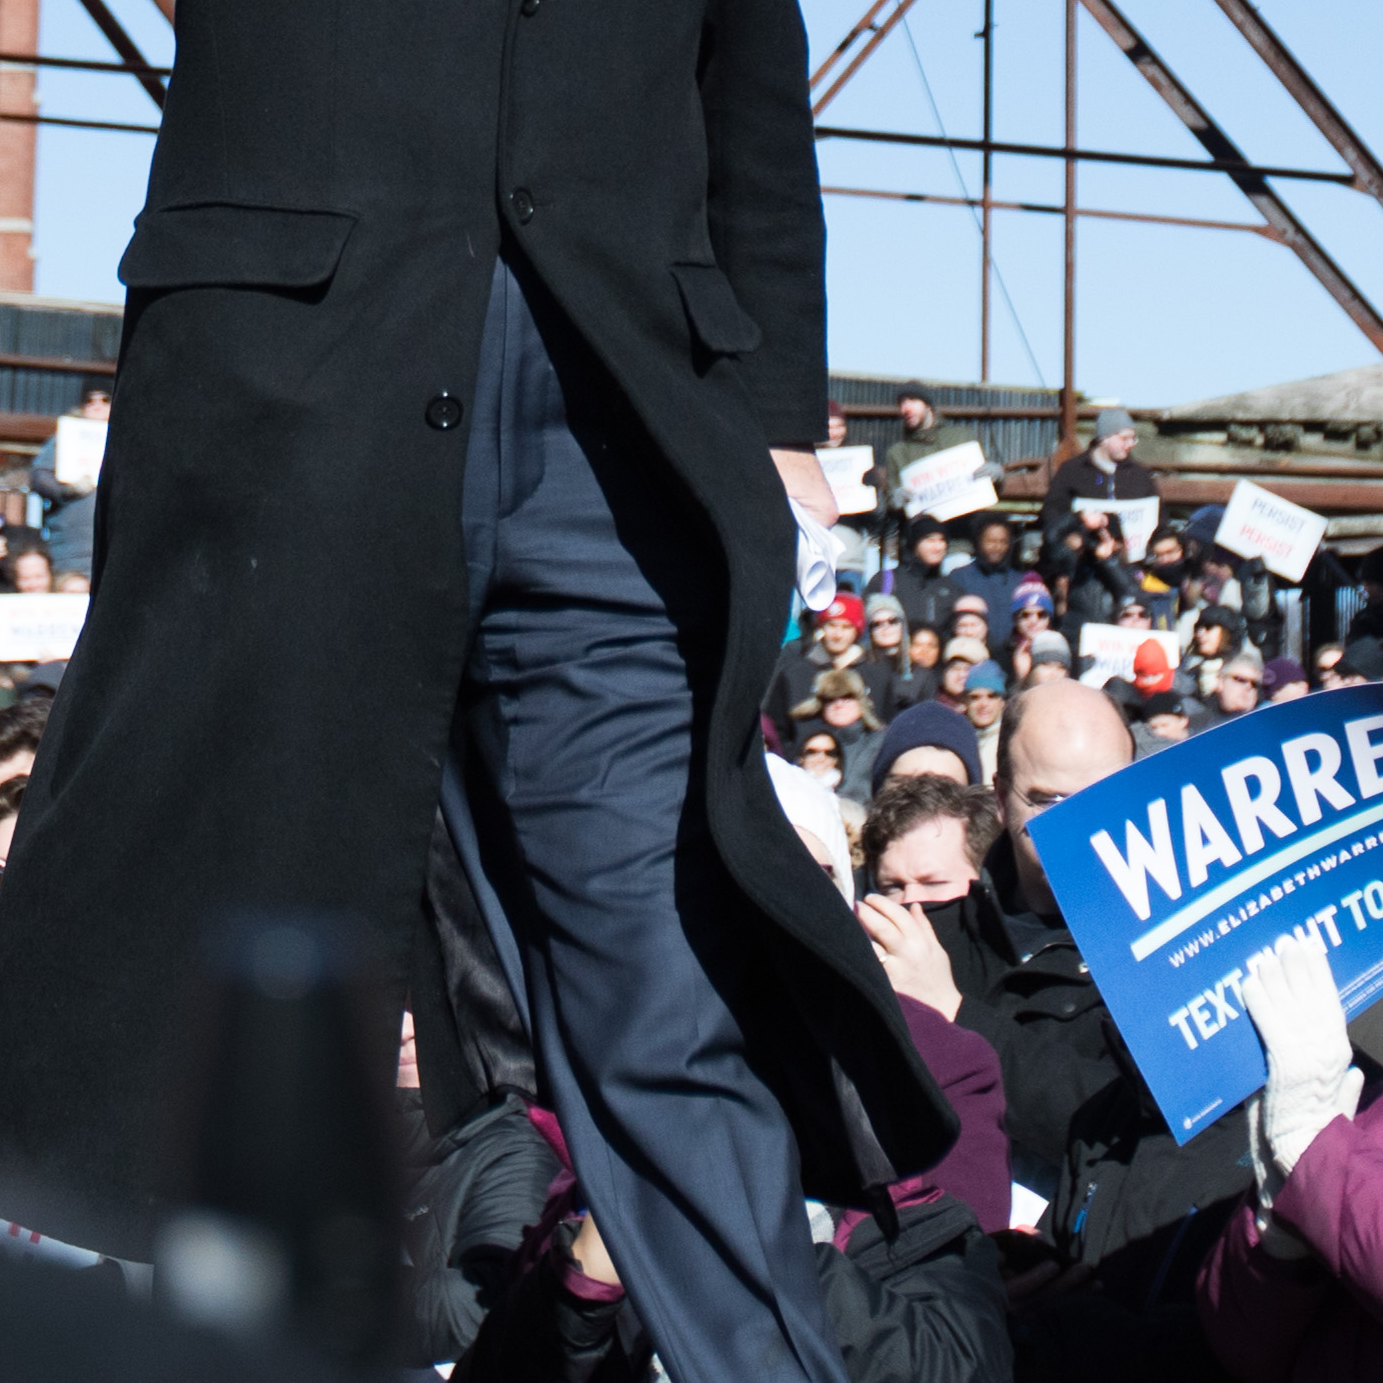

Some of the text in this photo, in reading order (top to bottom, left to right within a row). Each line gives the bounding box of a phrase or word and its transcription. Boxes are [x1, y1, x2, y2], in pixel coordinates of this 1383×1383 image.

[1251, 498, 1306, 532] PERSIST
[1239, 524, 1294, 559] PERSIST
[1168, 968, 1247, 1050] TEXT
